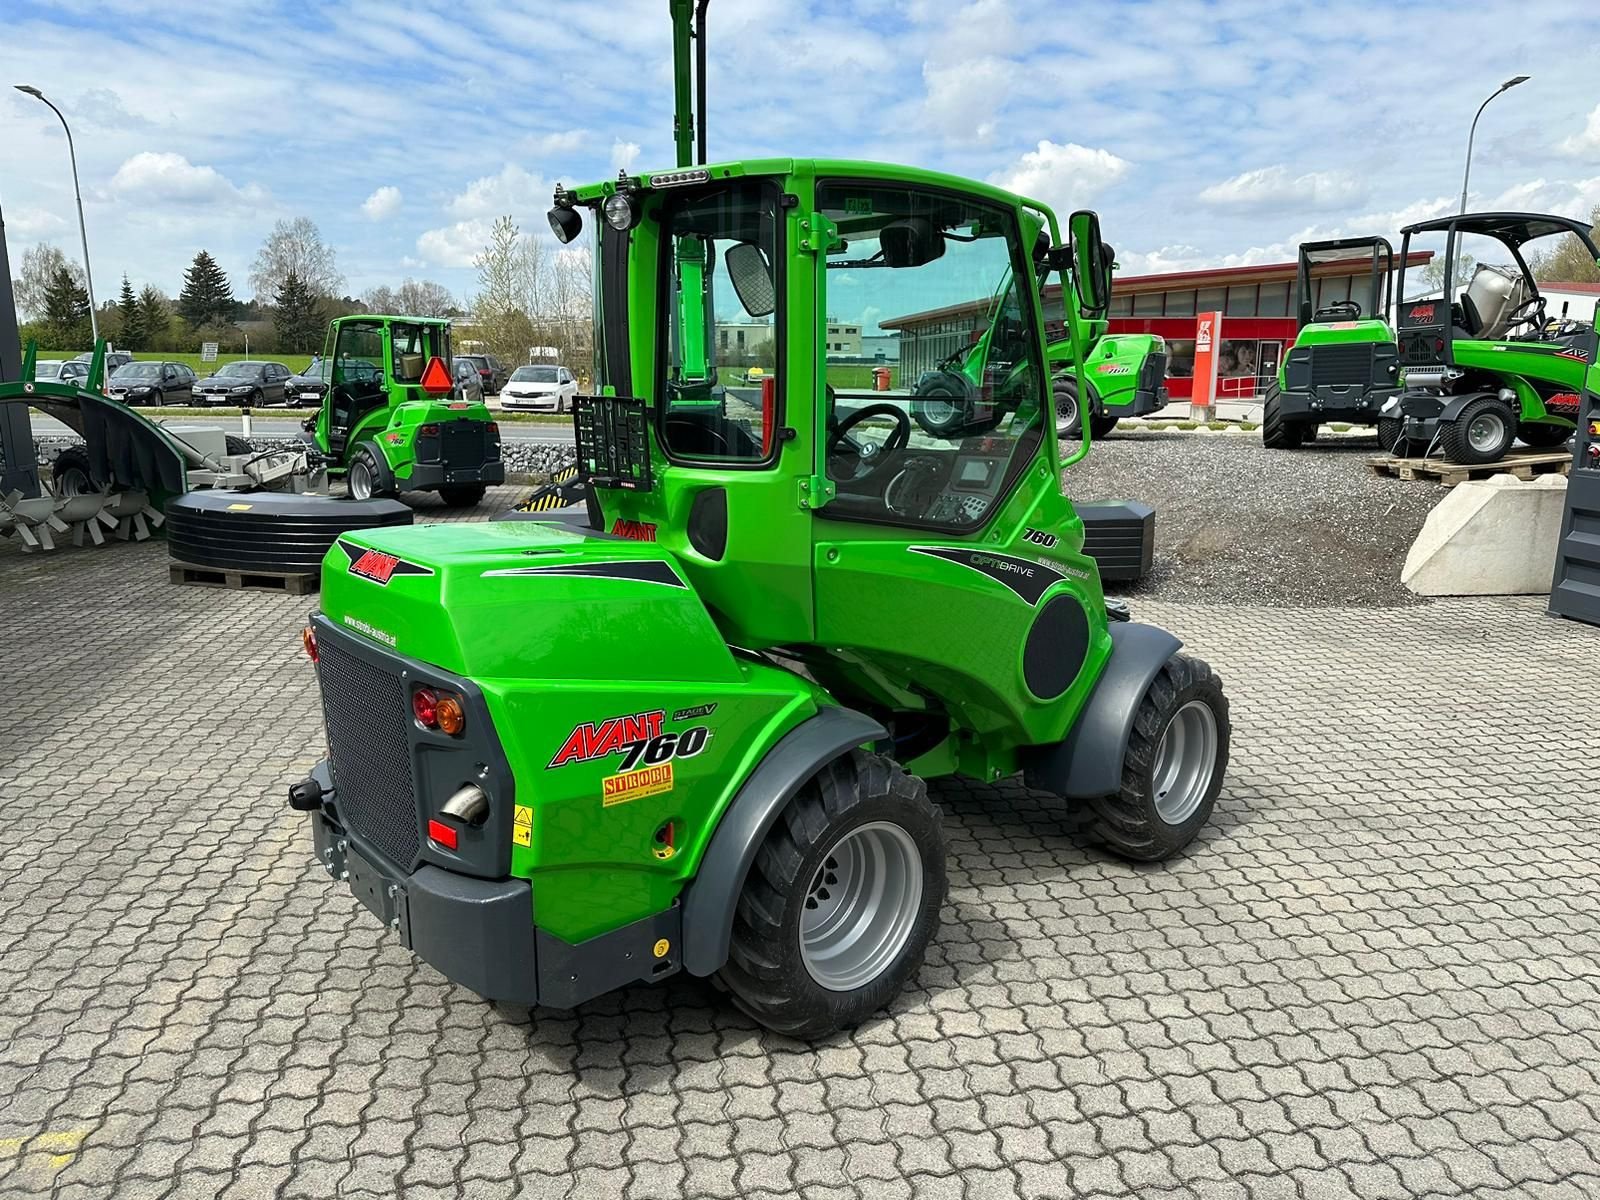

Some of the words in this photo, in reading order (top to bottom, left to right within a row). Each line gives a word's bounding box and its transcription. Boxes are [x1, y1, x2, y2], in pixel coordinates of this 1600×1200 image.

[611, 518, 658, 542] AVANT
[349, 548, 401, 583] AVANT
[547, 710, 666, 769] AVANT
[605, 765, 672, 795] STROBL
